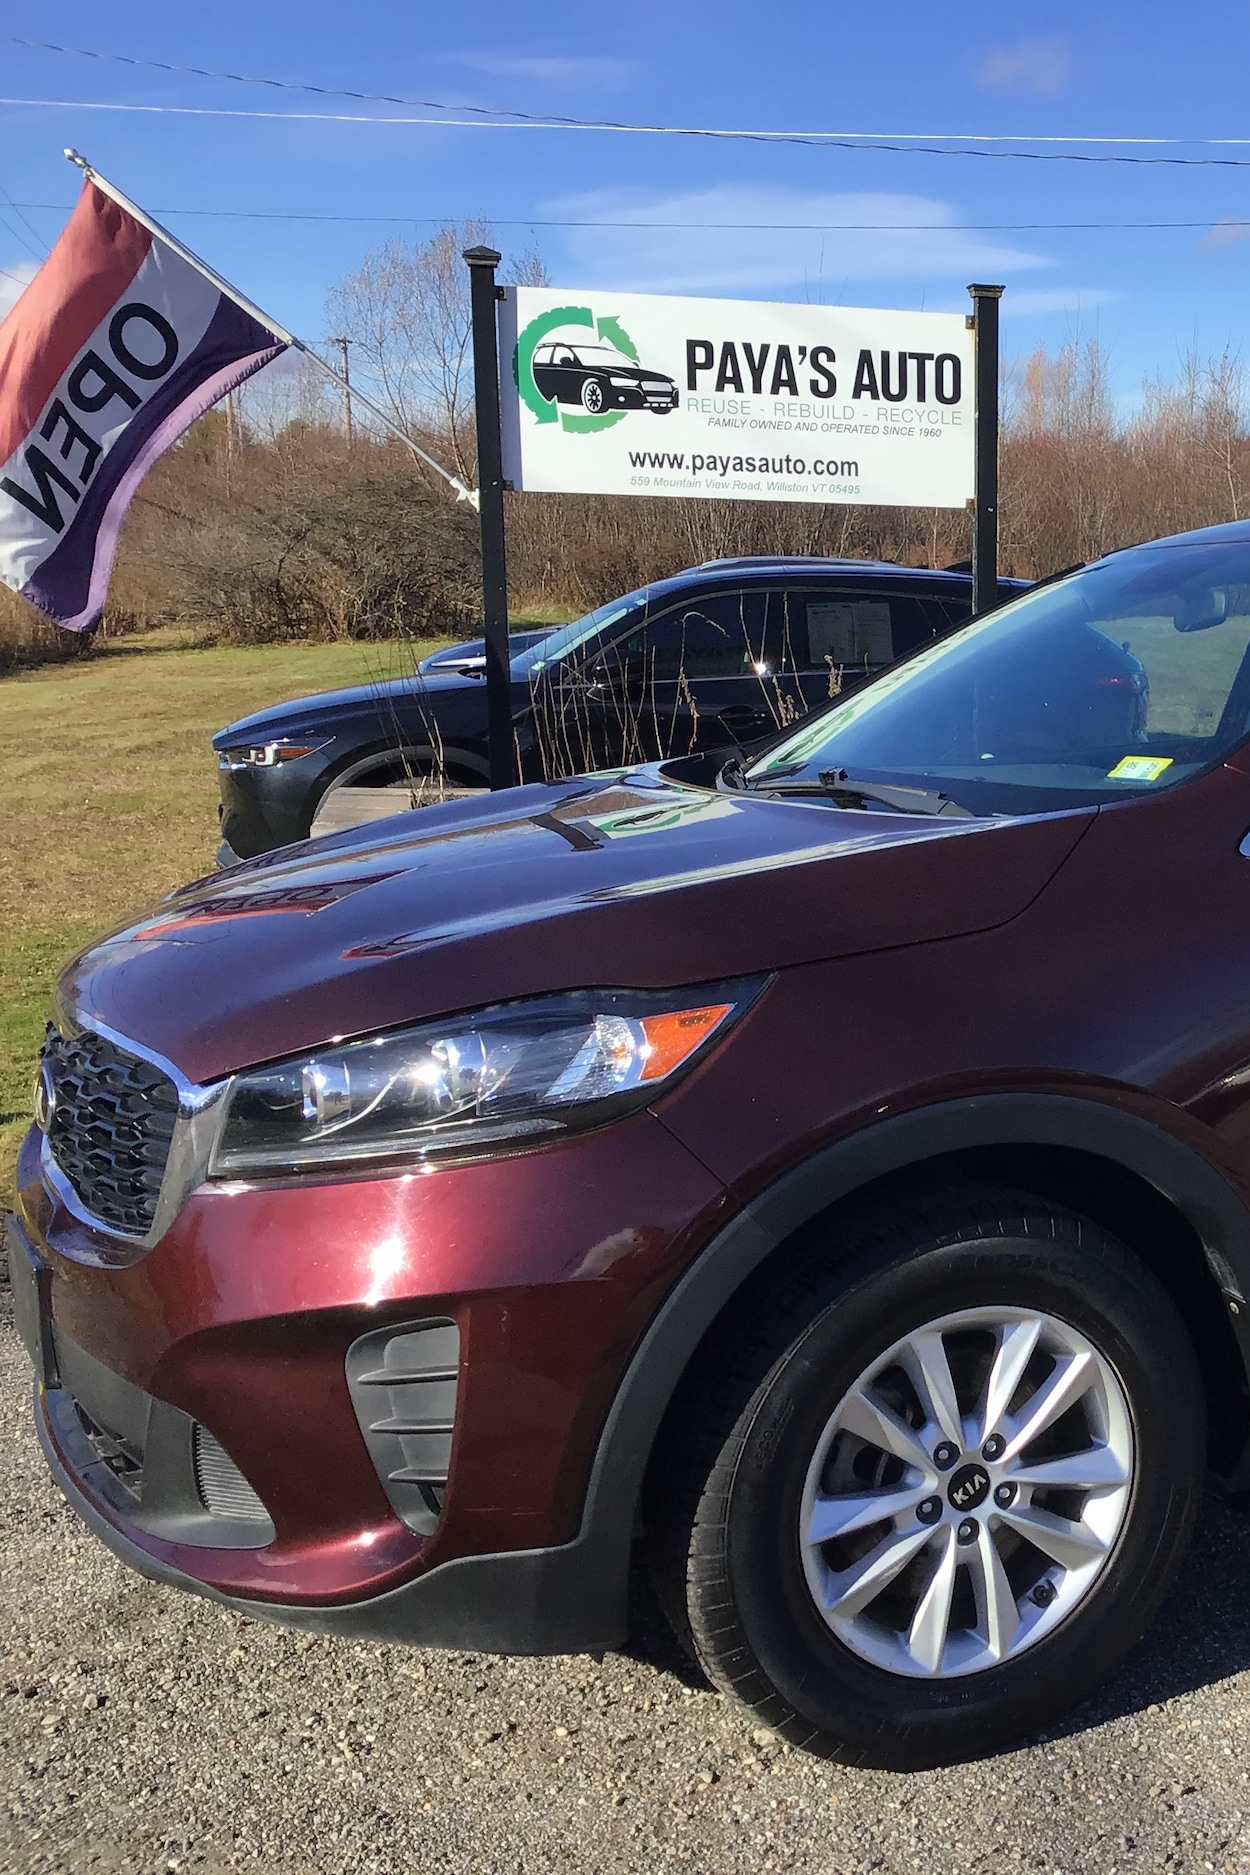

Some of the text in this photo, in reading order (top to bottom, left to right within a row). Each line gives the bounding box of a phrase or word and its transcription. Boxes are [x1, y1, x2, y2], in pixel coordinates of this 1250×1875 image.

[686, 339, 962, 405] PAYA'S AUTO
[687, 398, 751, 415] REUSE
[774, 402, 855, 421] REBUILD
[877, 407, 962, 426] RECYCLE
[707, 417, 942, 438] FAMILY OWNED AND OPERATED SINCE 1960
[629, 451, 859, 477] www.payasauto.com
[630, 476, 861, 495] 559 Mountain View Road, Williston VT 05495
[952, 1473, 987, 1505] KIA
